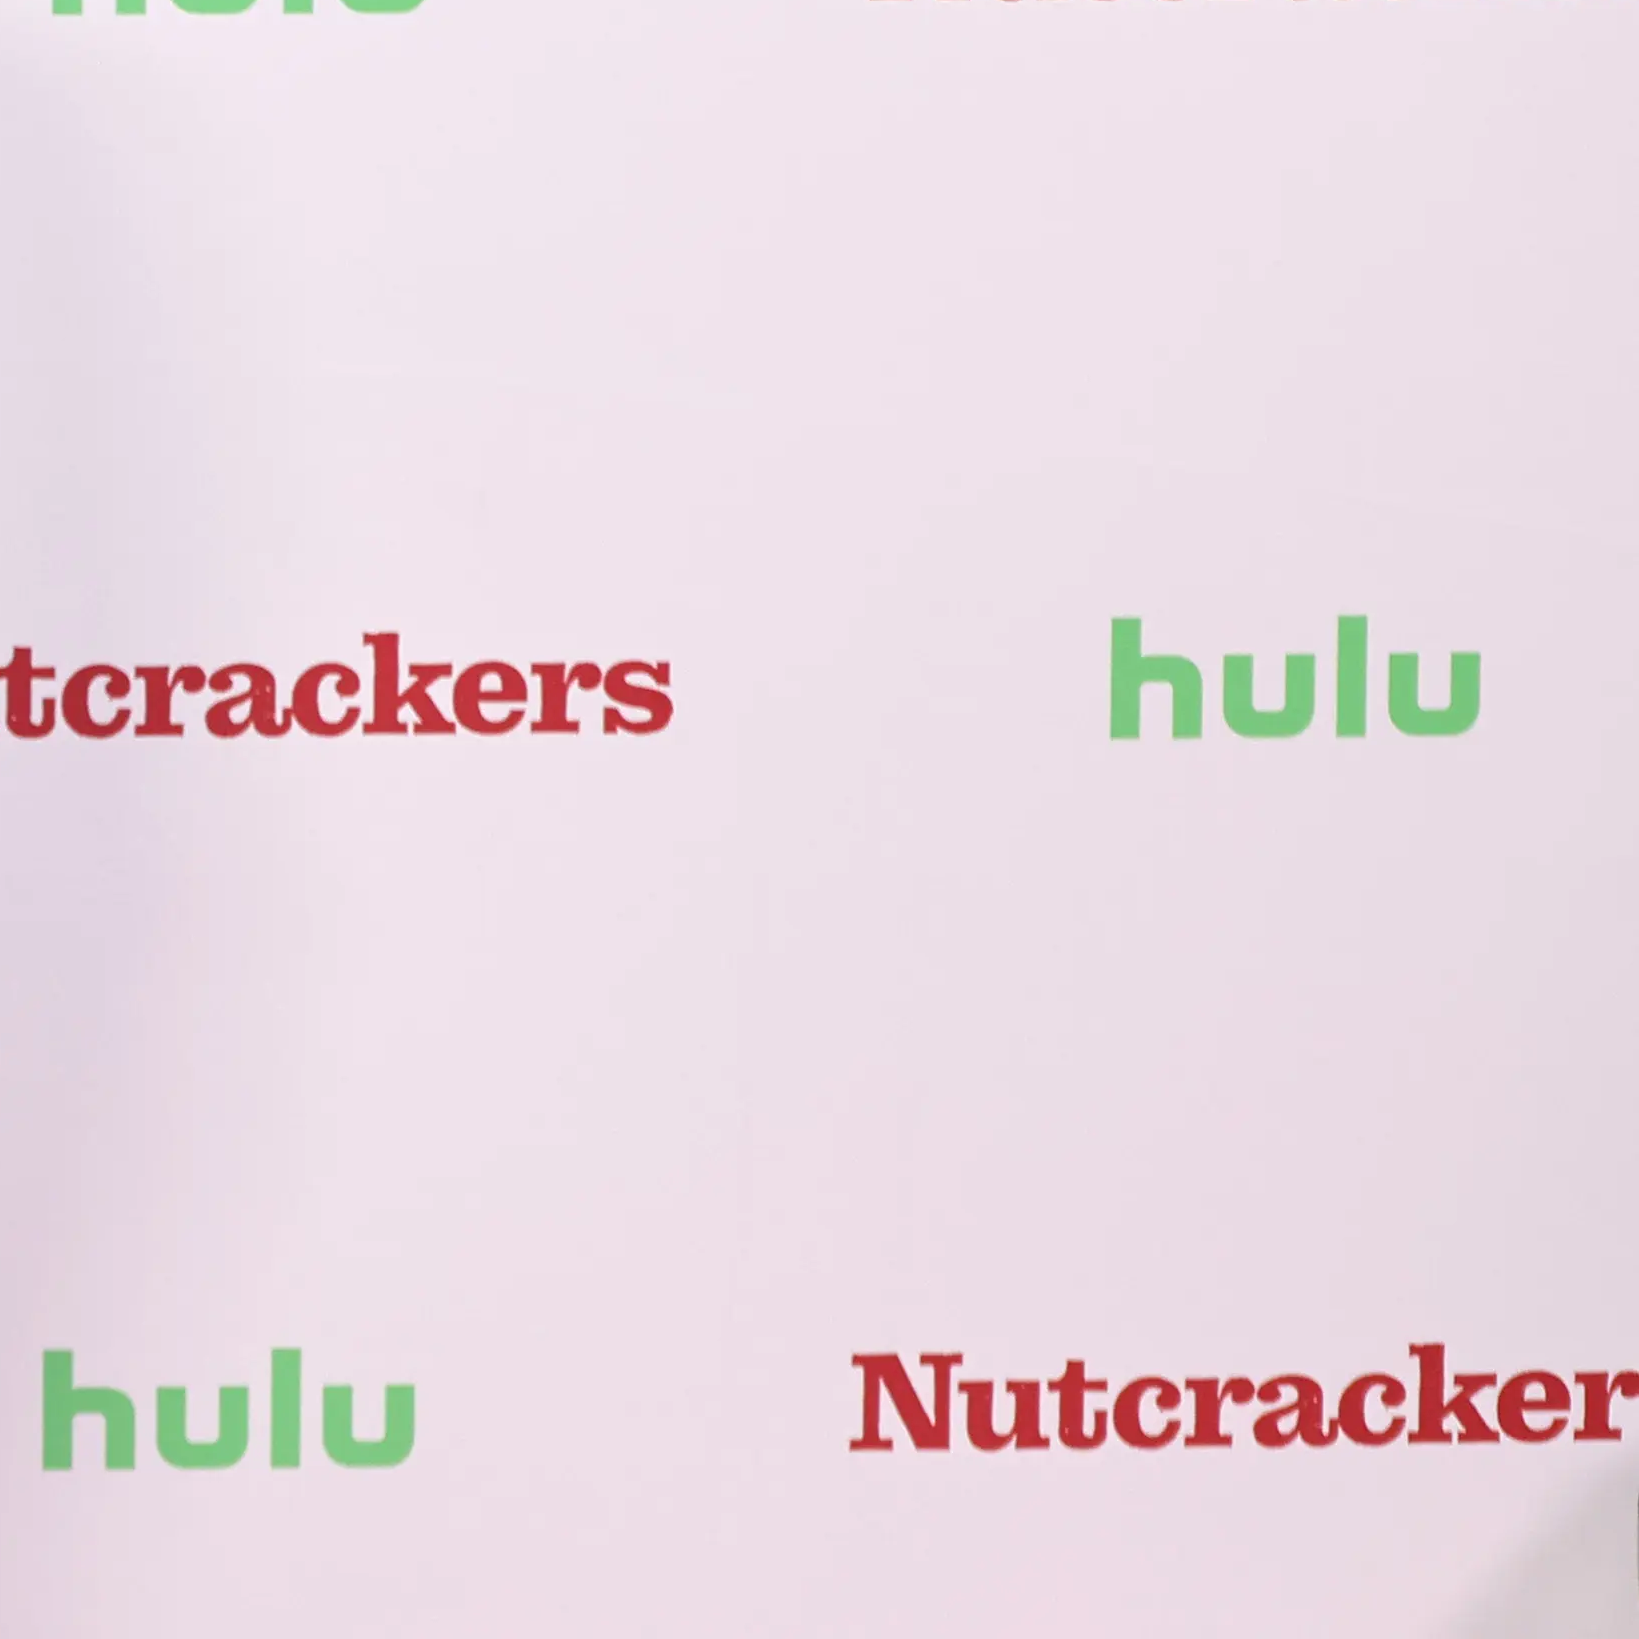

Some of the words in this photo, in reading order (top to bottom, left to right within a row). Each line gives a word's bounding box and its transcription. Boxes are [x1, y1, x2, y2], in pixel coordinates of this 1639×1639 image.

[1109, 615, 1481, 740] hulu
[42, 1347, 416, 1471] hulu
[849, 1342, 1639, 1451] Nutcracker
